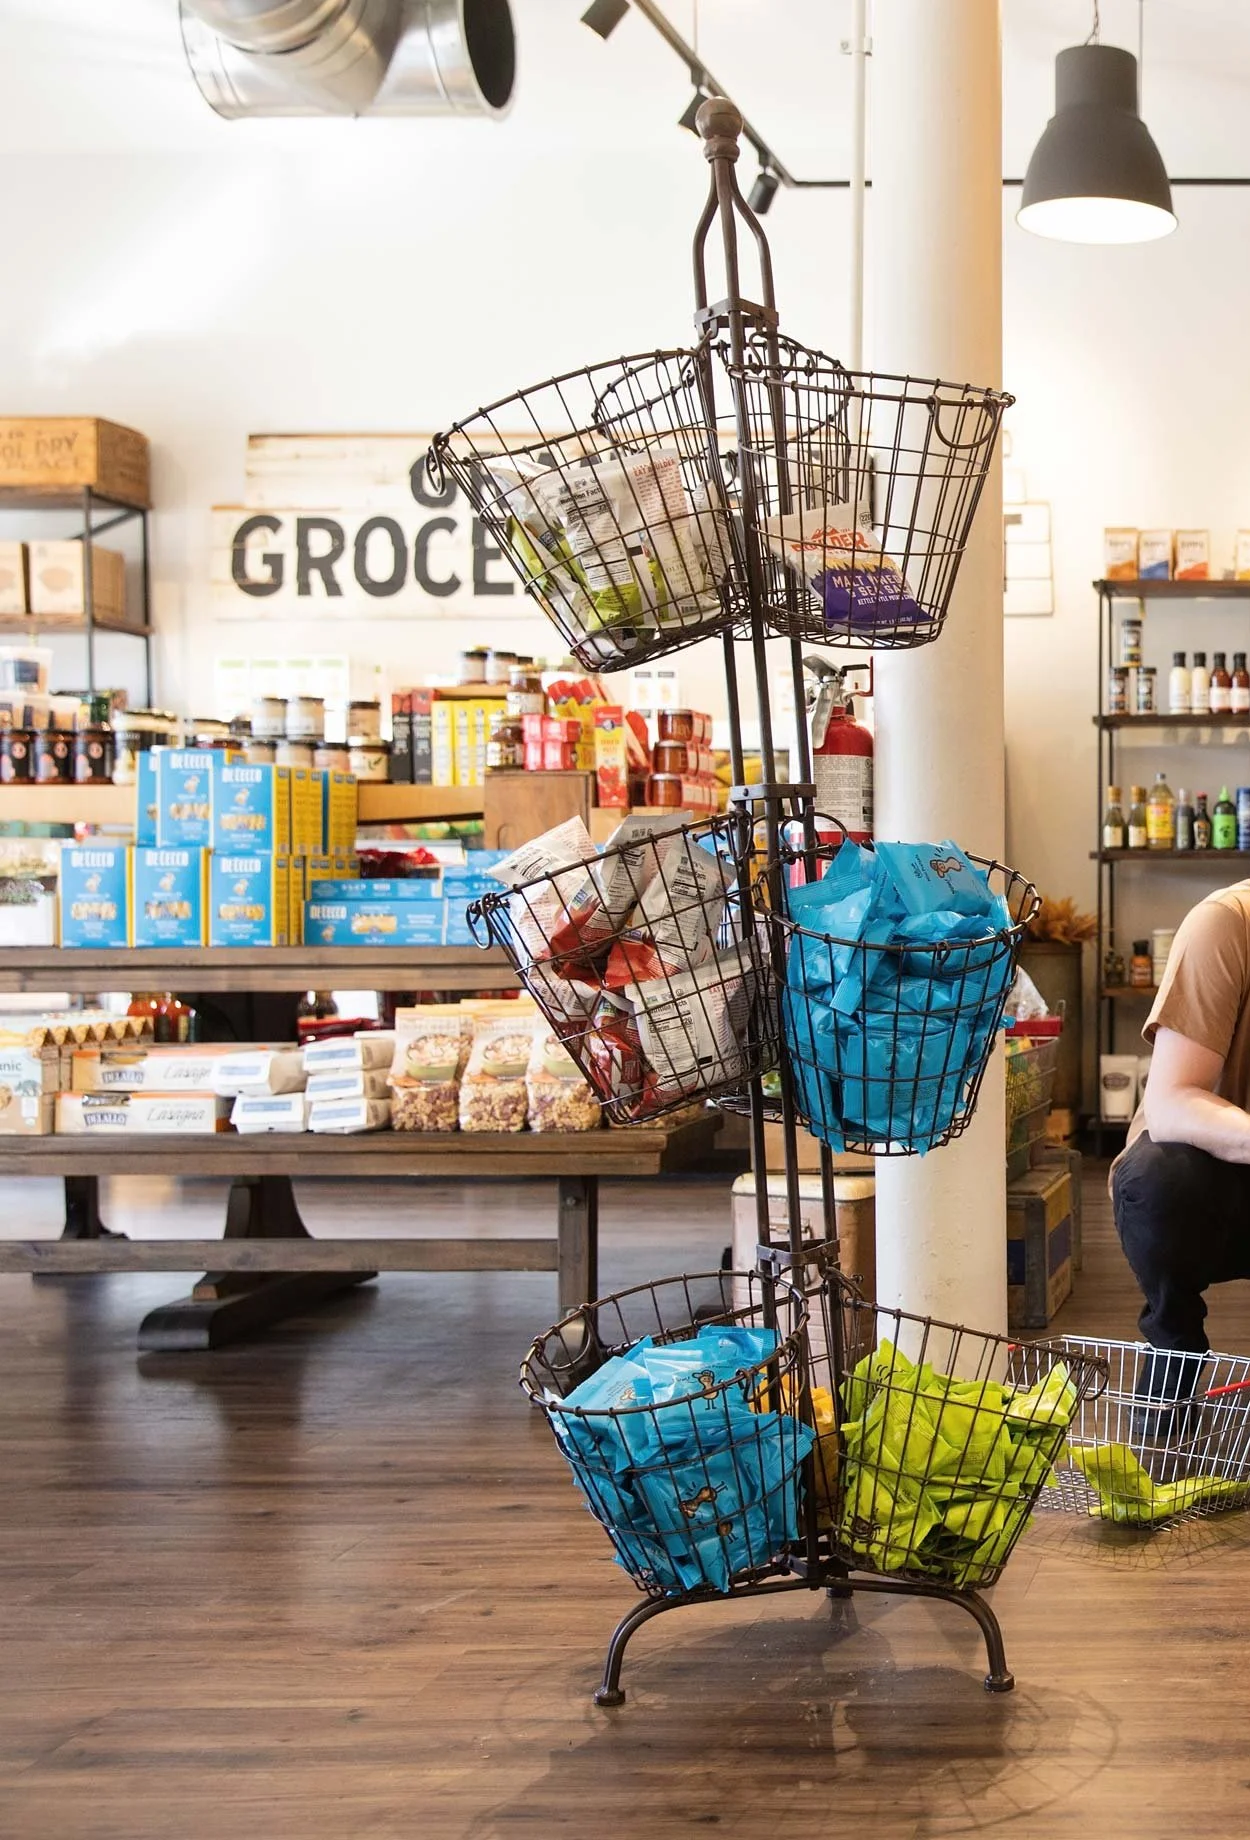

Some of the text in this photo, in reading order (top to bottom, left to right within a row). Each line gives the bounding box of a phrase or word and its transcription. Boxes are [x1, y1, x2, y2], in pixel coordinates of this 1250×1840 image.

[231, 514, 516, 598] GROCE
[163, 1062, 212, 1084] Lasagn
[147, 1106, 206, 1124] Lasagna
